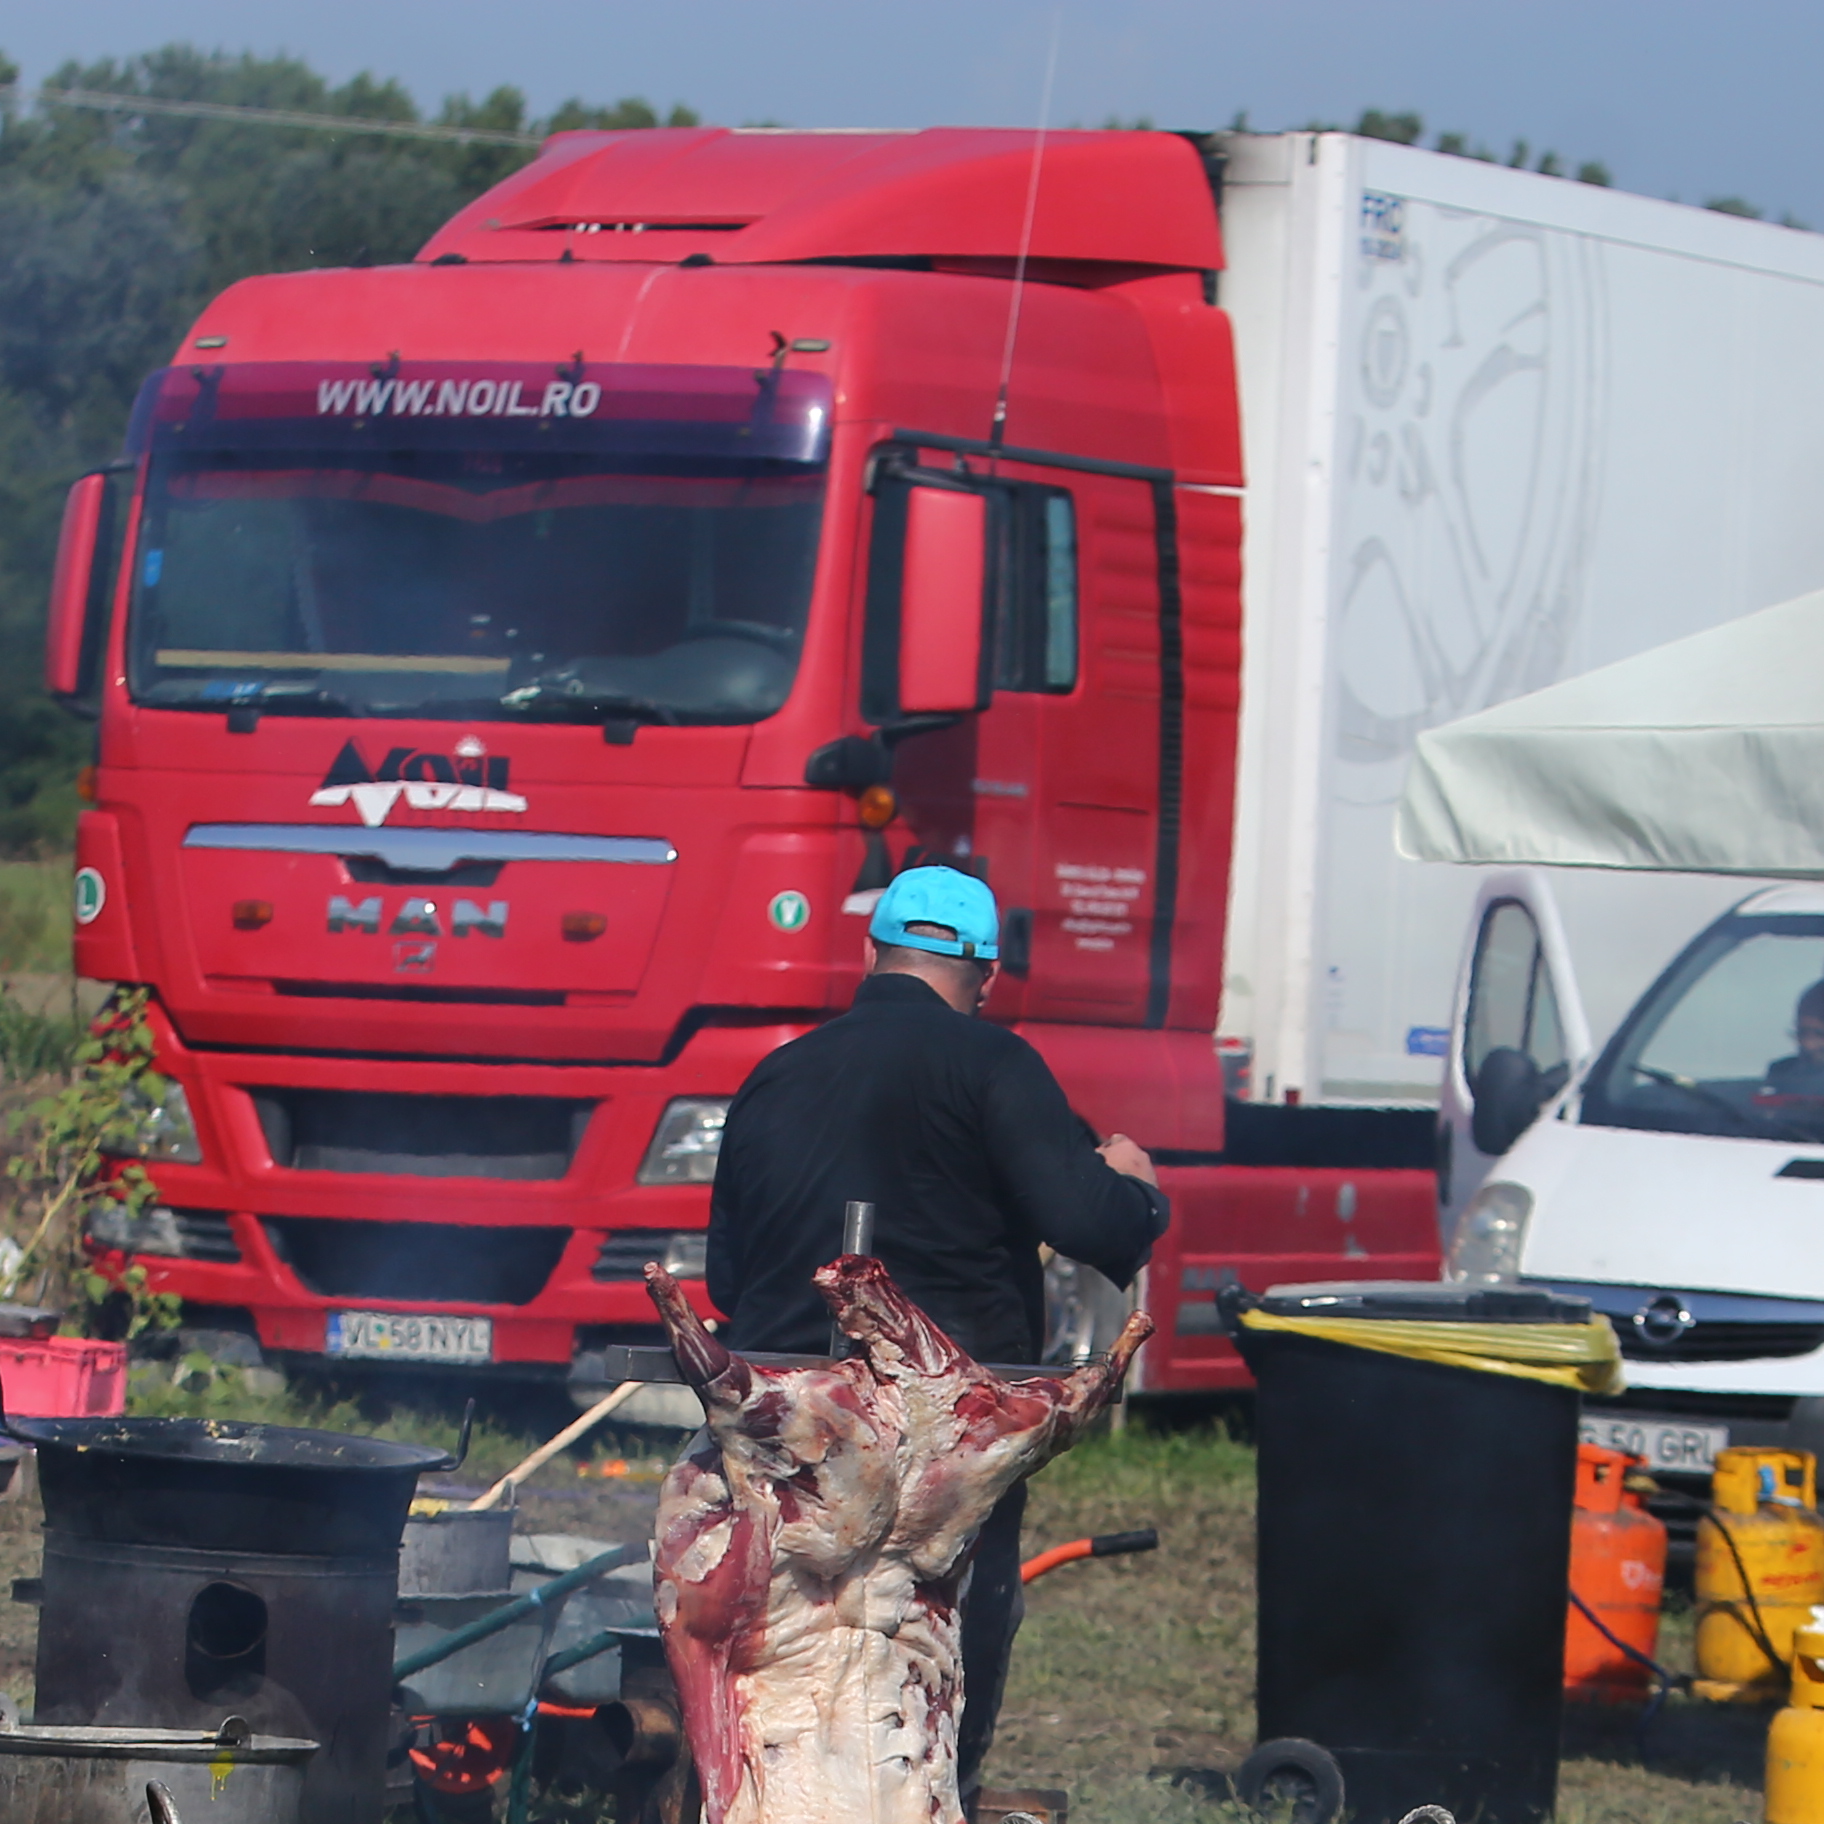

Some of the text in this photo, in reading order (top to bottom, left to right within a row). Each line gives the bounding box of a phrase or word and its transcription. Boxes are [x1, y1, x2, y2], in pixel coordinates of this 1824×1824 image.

[317, 379, 602, 418] WWW.NOIL.RO
[327, 894, 509, 938] MAN
[1657, 1428, 1716, 1465] GRL
